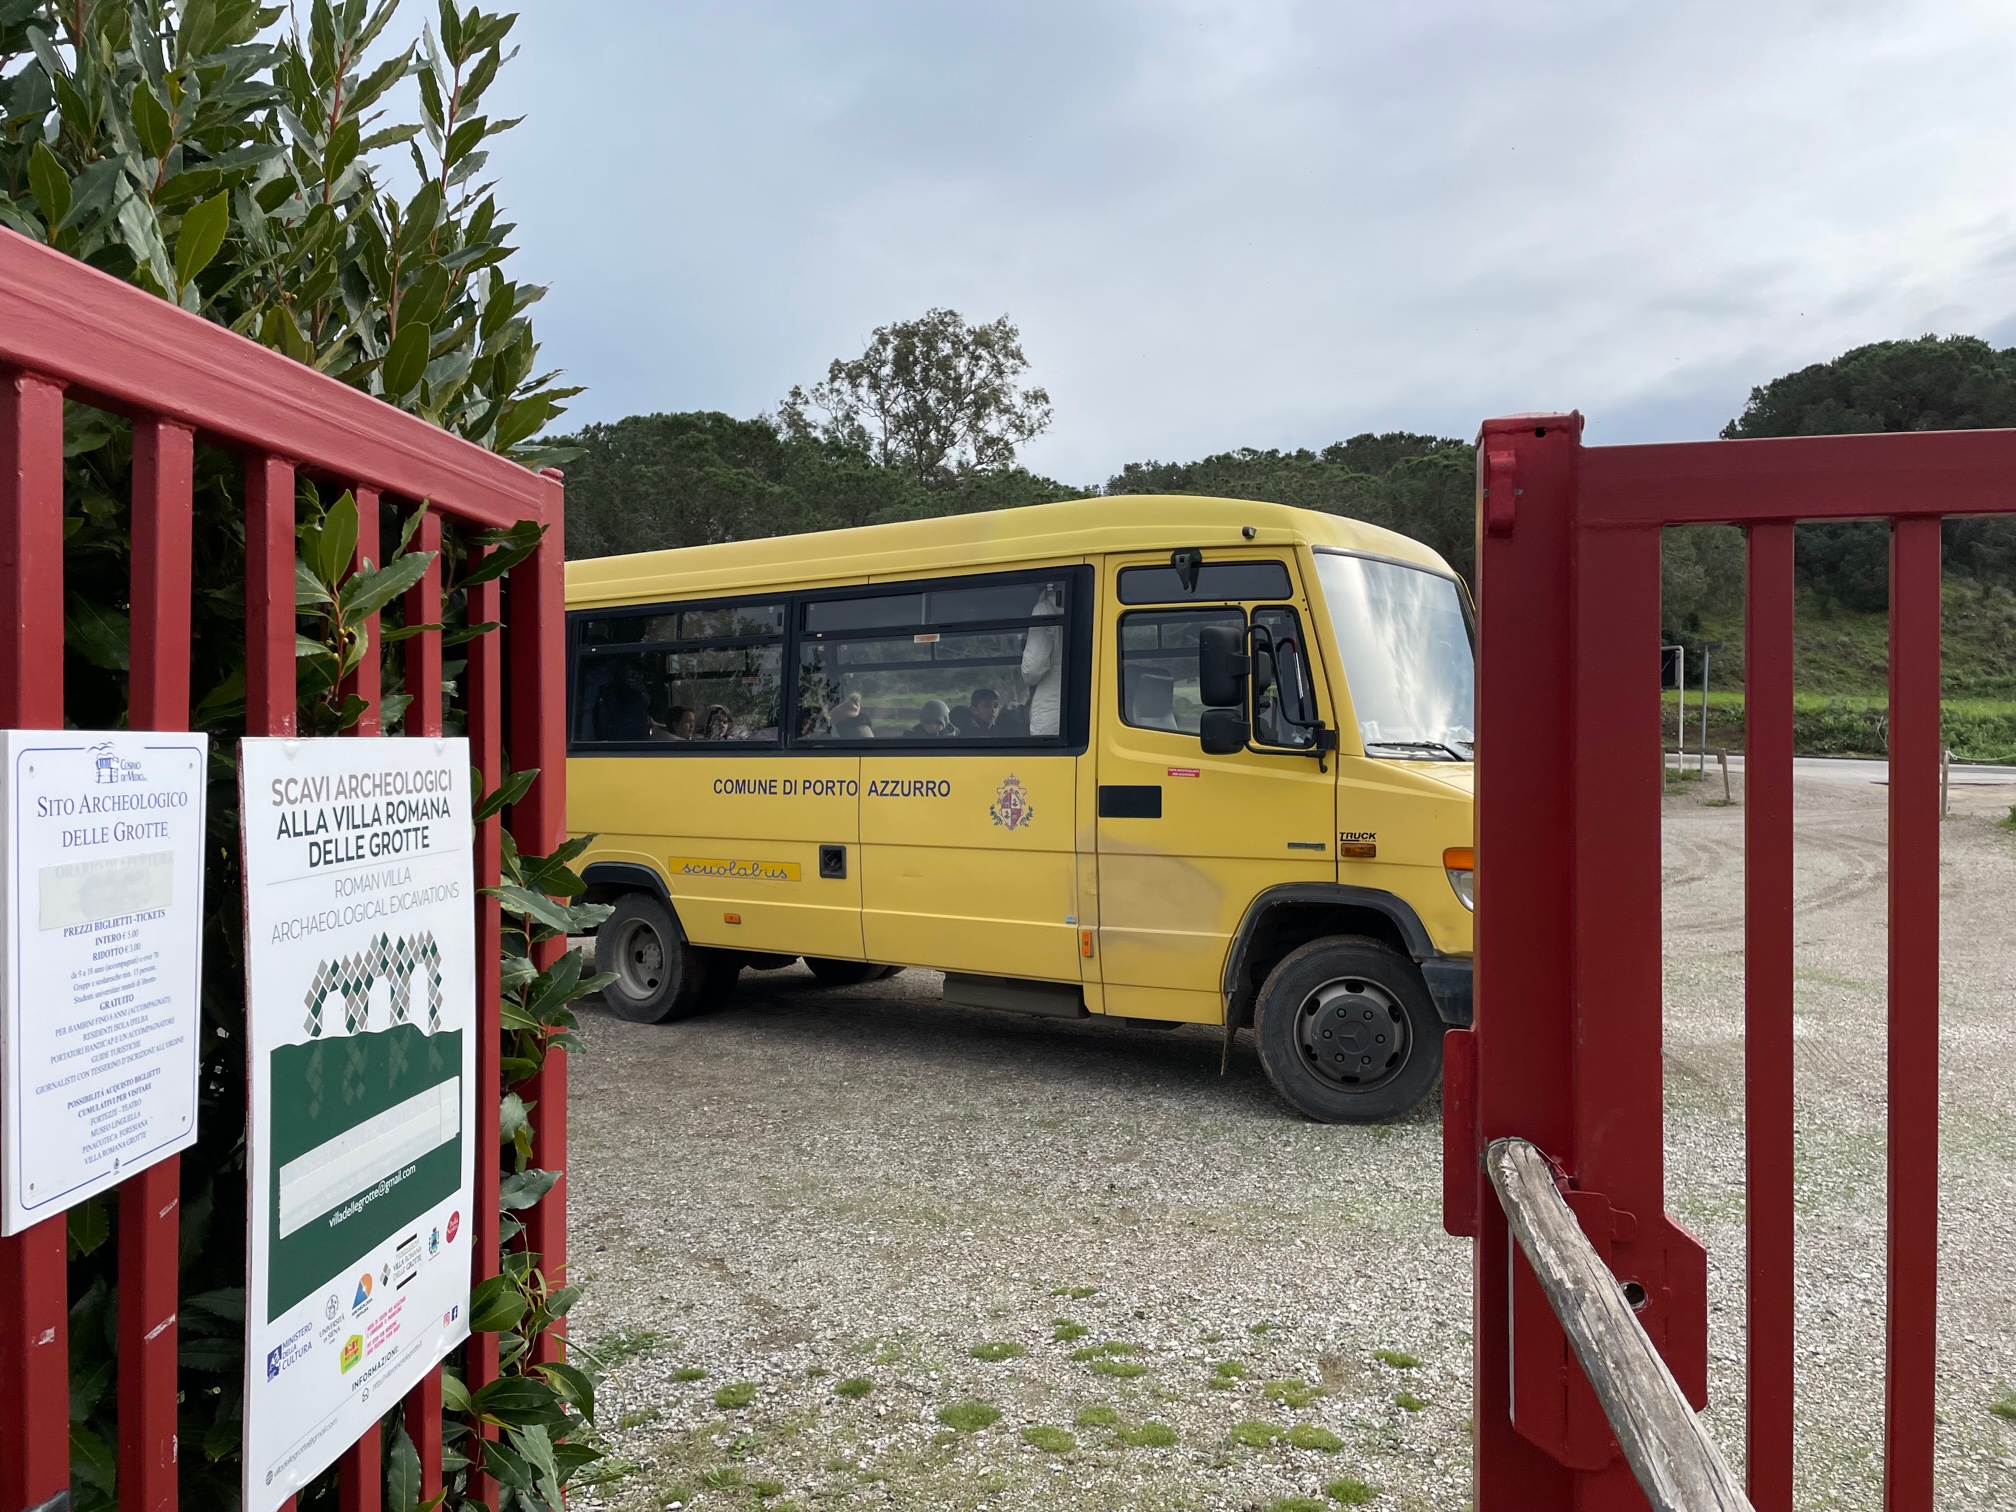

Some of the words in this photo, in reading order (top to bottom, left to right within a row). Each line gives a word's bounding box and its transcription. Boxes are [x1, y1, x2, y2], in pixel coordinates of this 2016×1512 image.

[271, 776, 330, 806] SCAVI
[334, 769, 452, 800] ARCHEOLOGICI
[713, 778, 778, 796] COMUNE
[782, 780, 797, 796] DI
[802, 780, 858, 796] PORTO
[868, 780, 950, 797] AZZURRO
[37, 796, 74, 818] SITO
[78, 792, 188, 814] ARCHEOLOGICO
[276, 808, 329, 840] ALLA
[332, 802, 382, 832] VILLA
[386, 796, 451, 825] ROMANA
[62, 826, 110, 848] DELLE
[114, 822, 168, 842] GROTTE
[308, 834, 365, 868] DELLE
[369, 826, 430, 858] GROTTE
[1340, 832, 1376, 841] TRUCK
[335, 873, 380, 898] ROMAN
[381, 866, 412, 888] VILLA
[682, 860, 788, 879] scuolabus
[64, 923, 92, 937] PREZZI
[94, 915, 132, 932] BIGLIETTI
[271, 898, 388, 945] ARCHAEOLOGICAL
[390, 882, 460, 914] EXCAVATIONS
[92, 946, 124, 961] RIDOTTO
[124, 946, 129, 954] €
[130, 942, 141, 952] 3.00
[95, 932, 121, 946] INTERO
[127, 929, 139, 939] 5.00
[87, 968, 93, 976] 18
[134, 968, 139, 976] 15
[100, 994, 134, 1010] GRATUITO
[55, 1028, 67, 1037] PER
[68, 1018, 95, 1034] BAMBINI
[95, 1012, 109, 1026] FINO
[113, 1008, 127, 1020] ANNI
[83, 1024, 113, 1041] RESIDENTI
[113, 1020, 130, 1032] ISOLA
[130, 1014, 148, 1028] D'ELBA
[50, 1047, 84, 1064] PORTATORI
[84, 1038, 114, 1054] HANDICAP
[127, 1017, 175, 1038] ACCOMPAGNATORE
[91, 1051, 109, 1064] GUIDE
[110, 1040, 141, 1058] TURISTICHE
[35, 1075, 76, 1095] GIORNALISTI
[77, 1070, 90, 1081] CON
[91, 1058, 120, 1076] TESSERINO
[106, 1078, 134, 1095] ACQUISTO
[134, 1067, 161, 1083] BIGLIETTI
[78, 1097, 115, 1118] CUMULATIVI
[116, 1093, 127, 1103] PER
[127, 1082, 152, 1098] VISITARE
[90, 1108, 118, 1126] FORTEZZE
[122, 1098, 141, 1113] TEATRO
[82, 1133, 118, 1154] PINACOTECA
[120, 1119, 148, 1138] FORESIANA
[90, 1124, 111, 1138] MUSEO
[112, 1111, 141, 1129] LINGUELLA
[84, 1152, 102, 1165] VILLA
[102, 1141, 126, 1158] ROMANA
[126, 1131, 147, 1146] GROTTE
[328, 1164, 416, 1228] villadellegrotte@gmail.com
[282, 1322, 312, 1350] MINISTERO
[282, 1344, 297, 1360] DELLA
[282, 1341, 312, 1370] CULTURA
